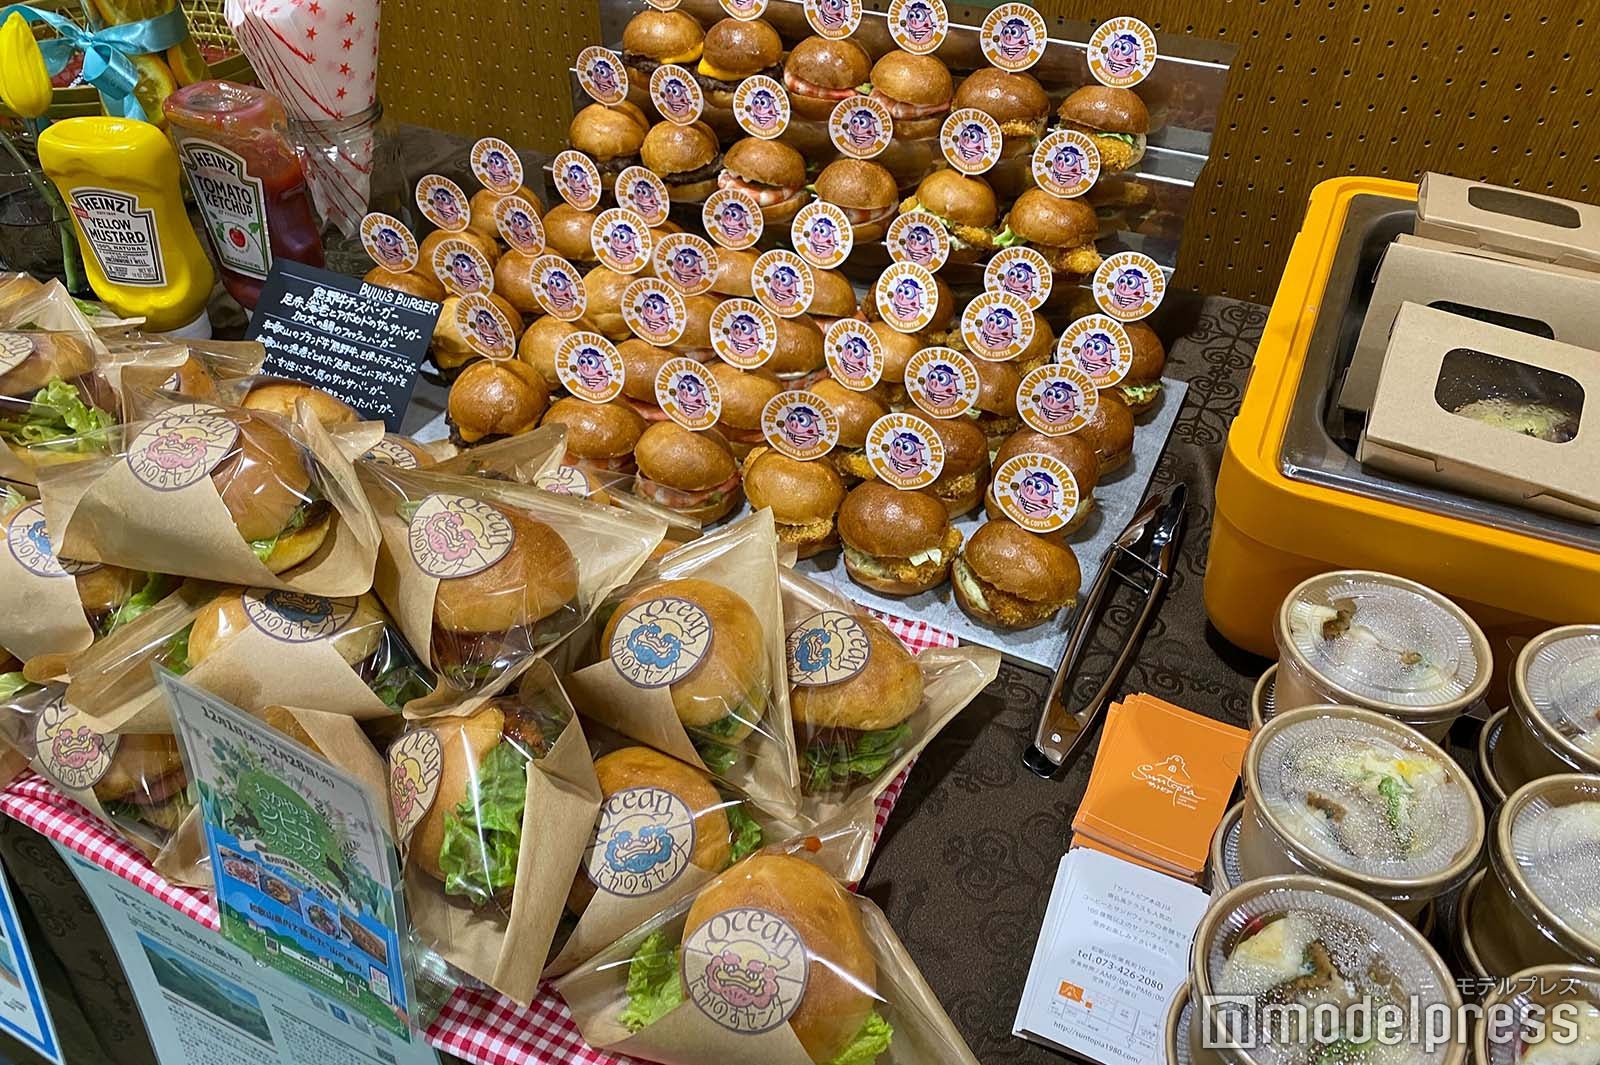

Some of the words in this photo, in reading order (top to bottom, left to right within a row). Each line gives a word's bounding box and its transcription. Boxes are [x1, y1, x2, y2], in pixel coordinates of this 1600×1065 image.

[1010, 5, 1044, 38] BURGER
[1128, 20, 1154, 61] BURGER
[599, 49, 626, 84] BURGER
[669, 67, 699, 99] BURGER
[758, 78, 787, 109] BURGER
[860, 97, 890, 131] BURGER
[972, 111, 999, 148] BURGER
[193, 151, 236, 176] HEINZ
[491, 140, 520, 172] BURGER
[571, 153, 598, 184] BURGER
[1067, 133, 1098, 169] BURGER
[194, 175, 253, 205] TOMATO
[435, 177, 467, 209] BURGER
[637, 168, 666, 200] BURGER
[81, 197, 126, 214] HEINZ
[203, 192, 254, 218] KETCHUP
[516, 200, 545, 234] BURGER
[732, 191, 761, 225] BURGER
[821, 205, 849, 240] BURGER
[88, 227, 147, 244] MUSTARD
[89, 217, 131, 231] YELLOW
[385, 217, 416, 254] BURGER
[621, 211, 649, 248] BURGER
[917, 213, 947, 249] BURGER
[456, 241, 490, 277] BURGER
[685, 236, 717, 270] BURGER
[1022, 250, 1050, 288] BURGER
[553, 258, 585, 296] BURGER
[785, 253, 811, 294] BURGER
[908, 265, 935, 304] BURGER
[1131, 255, 1162, 292] BURGER
[394, 294, 440, 317] BURGER
[477, 297, 512, 337] BURGER
[652, 280, 684, 319] BURGER
[1002, 294, 1032, 335] BURGER
[741, 301, 774, 339] BURGER
[582, 334, 621, 369] BURGER
[858, 324, 881, 370] BURGER
[1099, 319, 1130, 362] BURGER
[685, 360, 719, 402] BURGER
[940, 350, 976, 389] BURGER
[1059, 367, 1095, 405] BURGER
[798, 393, 837, 431] BURGER
[905, 417, 941, 462] BURGER
[1040, 457, 1075, 506] BURGER
[645, 599, 709, 639] Ocean
[836, 617, 868, 671] Ocean
[402, 732, 440, 785] Ocean
[707, 910, 798, 959] Ocean
